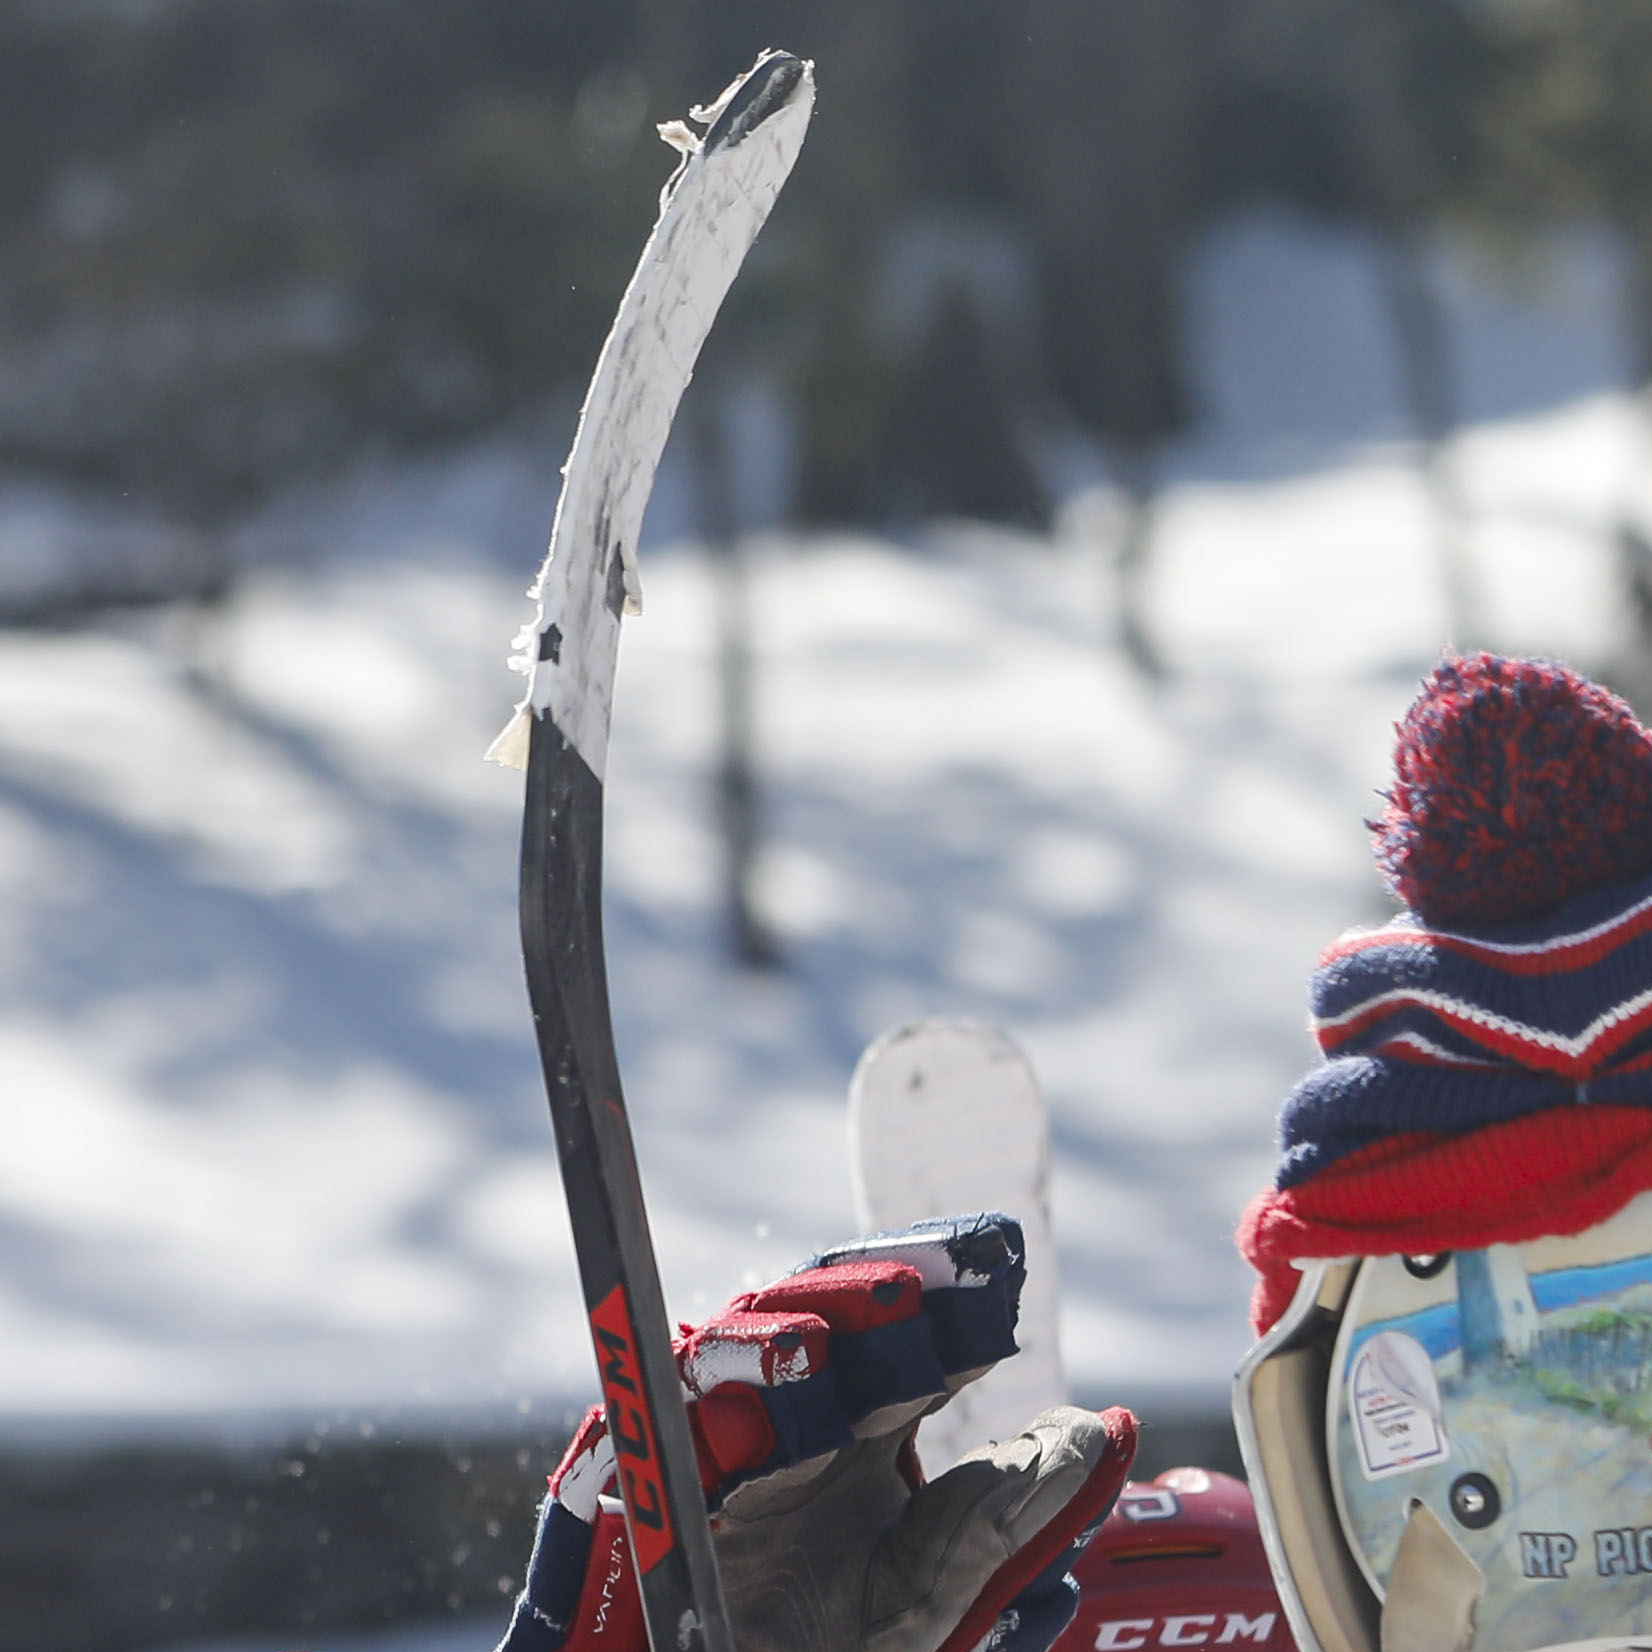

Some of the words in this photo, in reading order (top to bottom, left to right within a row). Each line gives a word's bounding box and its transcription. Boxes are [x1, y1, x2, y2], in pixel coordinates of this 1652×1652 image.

[595, 1324, 665, 1527] CCM
[1520, 1532, 1576, 1578] NP
[1094, 1612, 1277, 1652] CCM
